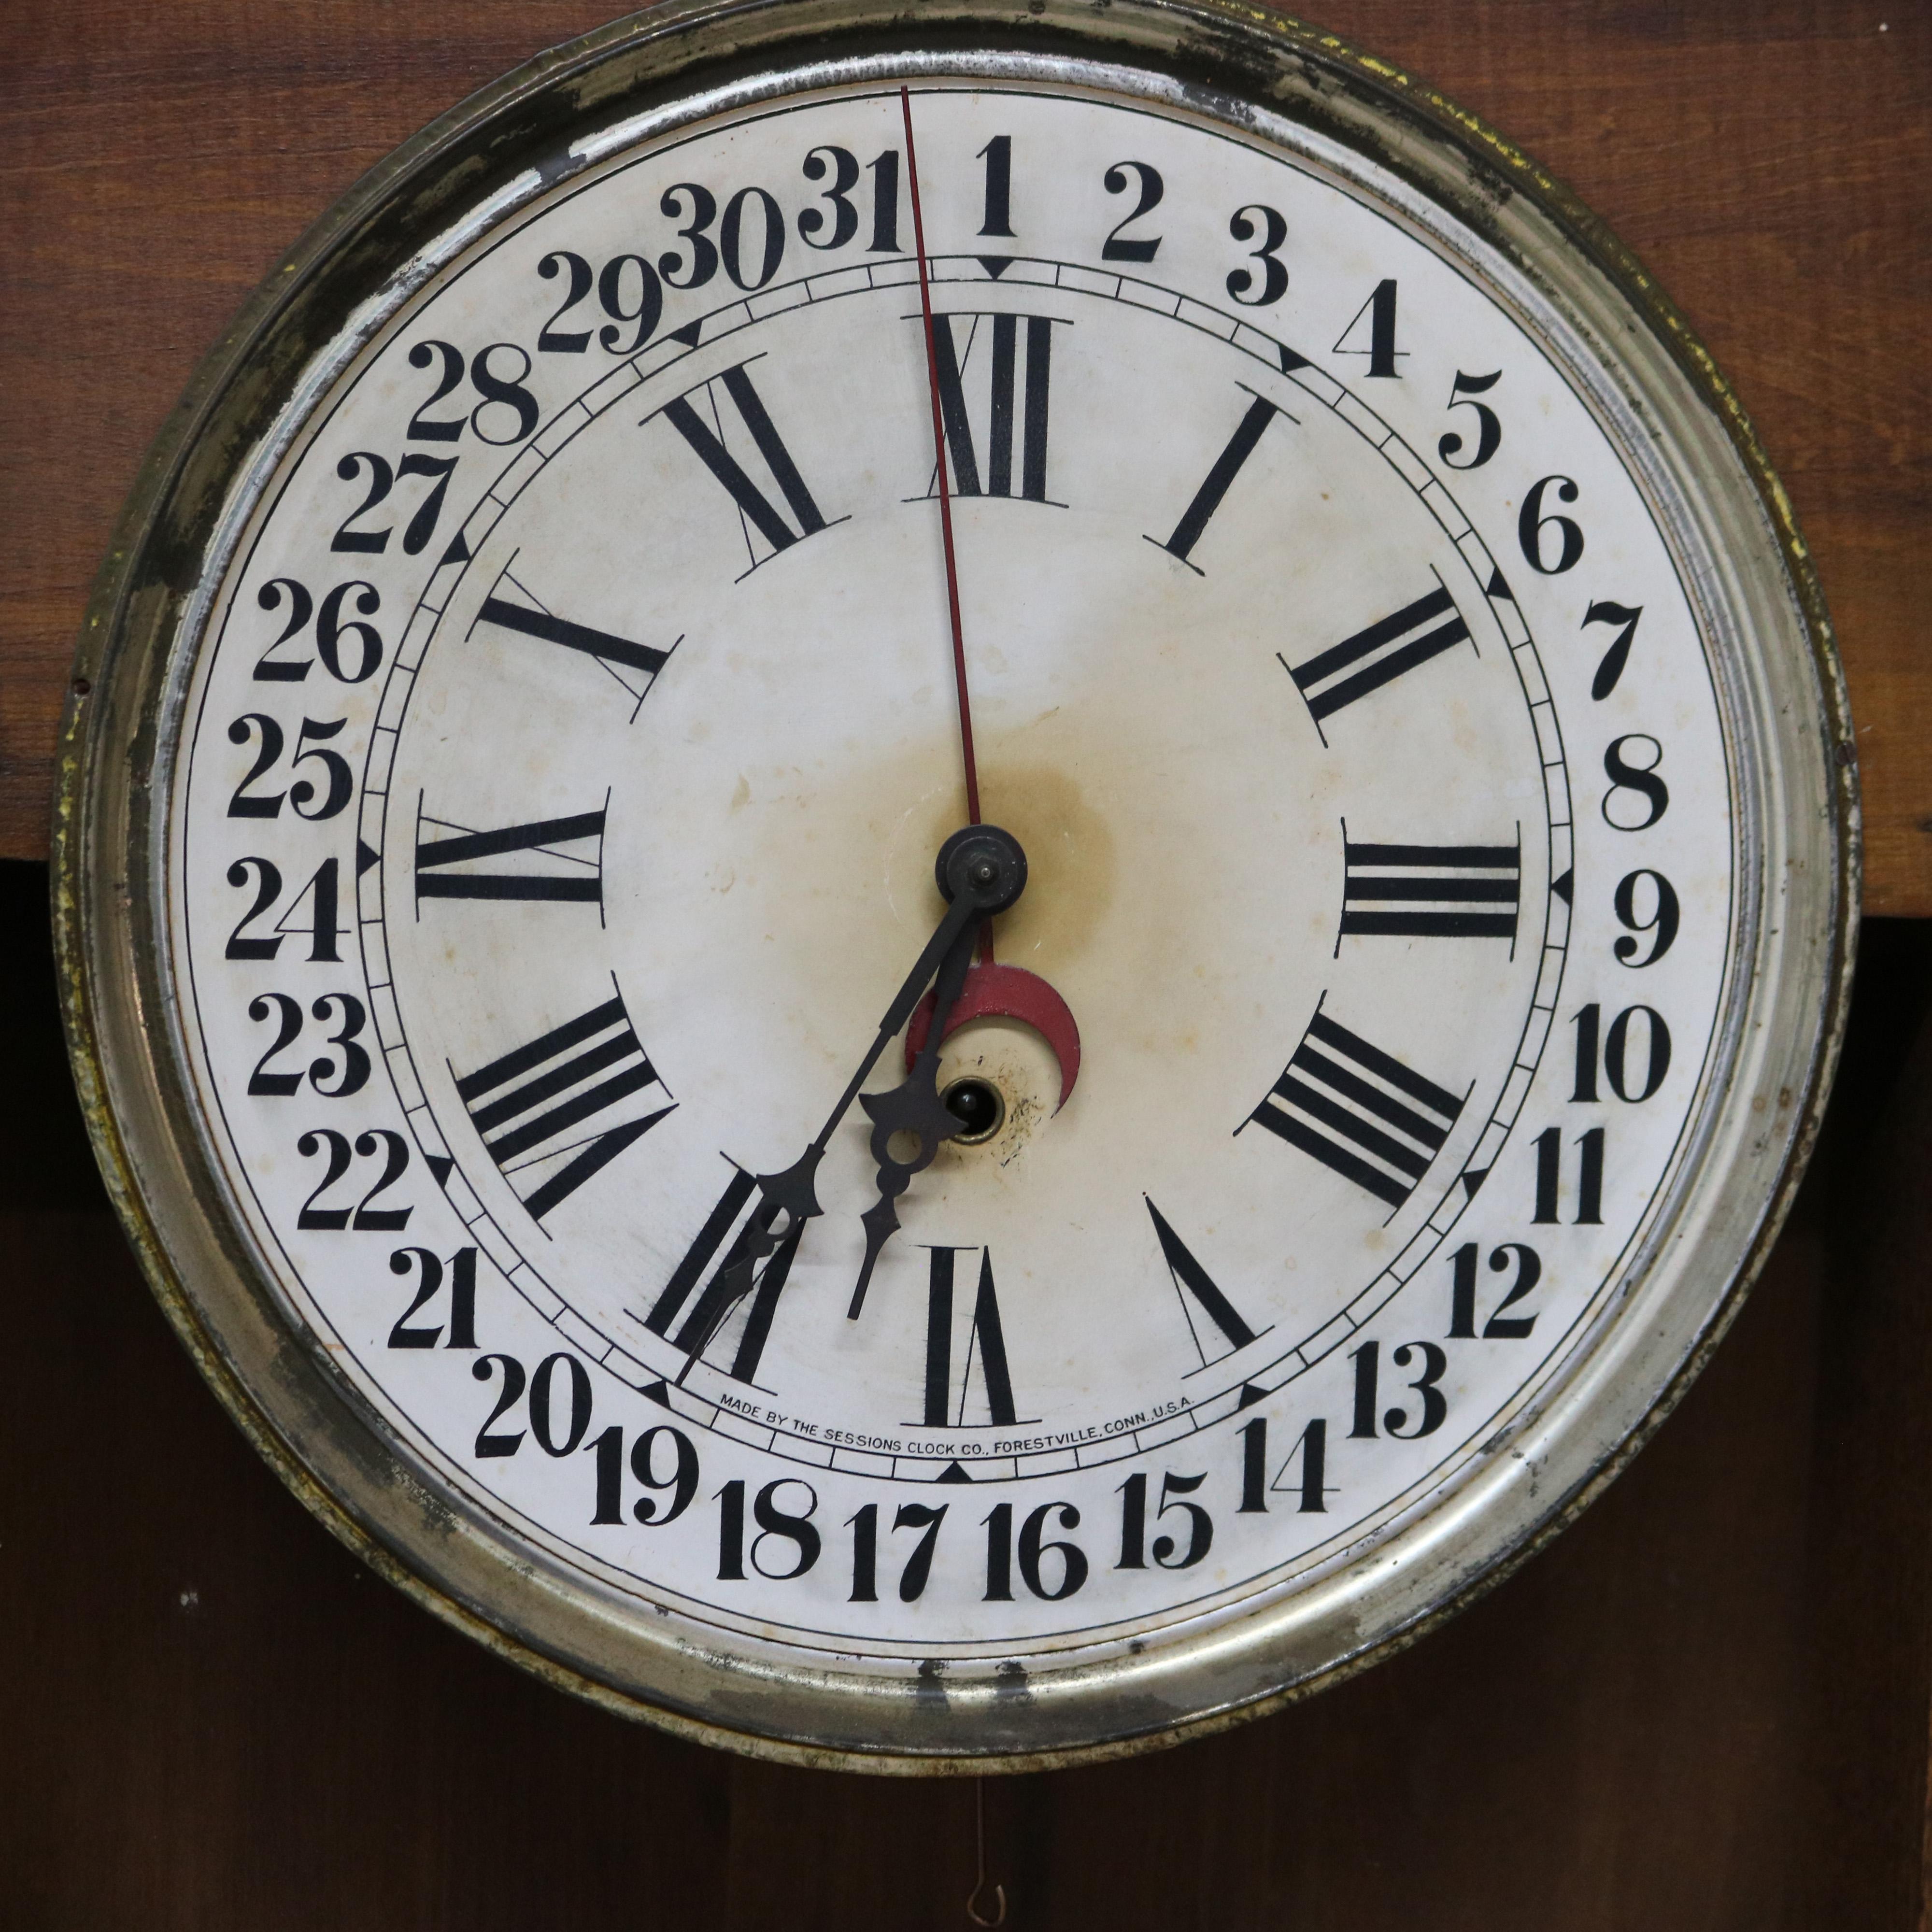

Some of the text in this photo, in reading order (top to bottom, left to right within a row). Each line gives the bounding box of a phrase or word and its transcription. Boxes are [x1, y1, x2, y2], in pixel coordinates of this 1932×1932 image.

[658, 183, 785, 292] 30
[797, 145, 905, 253] 31
[976, 136, 1018, 237] 1
[1102, 161, 1164, 263] 2
[538, 251, 663, 355] 29
[1226, 205, 1289, 306] 3
[1333, 279, 1410, 379] 4
[407, 340, 540, 446] 28
[900, 312, 1074, 507] XII
[1438, 369, 1502, 470] 5
[330, 452, 460, 555] 27
[638, 351, 852, 584] XI
[1518, 476, 1584, 575] 6
[253, 578, 384, 683] 26
[464, 548, 685, 725] X
[1278, 563, 1480, 749] II
[1580, 600, 1643, 701] 7
[227, 713, 353, 821] 25
[1601, 734, 1669, 832] 8
[413, 785, 611, 930] IX
[1334, 816, 1521, 963] III
[225, 856, 351, 963] 24
[1614, 869, 1680, 969] 9
[247, 993, 371, 1098] 23
[1568, 1003, 1671, 1104] 10
[445, 970, 680, 1241] VIII
[1233, 990, 1477, 1228] IIII
[297, 1129, 414, 1231] 22
[1530, 1127, 1605, 1224] 11
[387, 1247, 481, 1349] 21
[900, 1245, 1042, 1429] VI
[1143, 1192, 1276, 1380] V
[1444, 1242, 1541, 1339] 12
[472, 1352, 593, 1459] 20
[720, 1394, 761, 1418] MADE
[767, 1411, 788, 1425] BY
[793, 1420, 818, 1436] THE
[824, 1428, 901, 1451] SESSIONS
[908, 1442, 955, 1455] CLOCK
[1346, 1340, 1447, 1440] 13
[583, 1425, 699, 1526] 19
[1235, 1418, 1340, 1513] 14
[711, 1478, 822, 1580] 18
[843, 1503, 950, 1603] 17
[980, 1501, 1088, 1603] 16
[1113, 1471, 1214, 1570] 15
